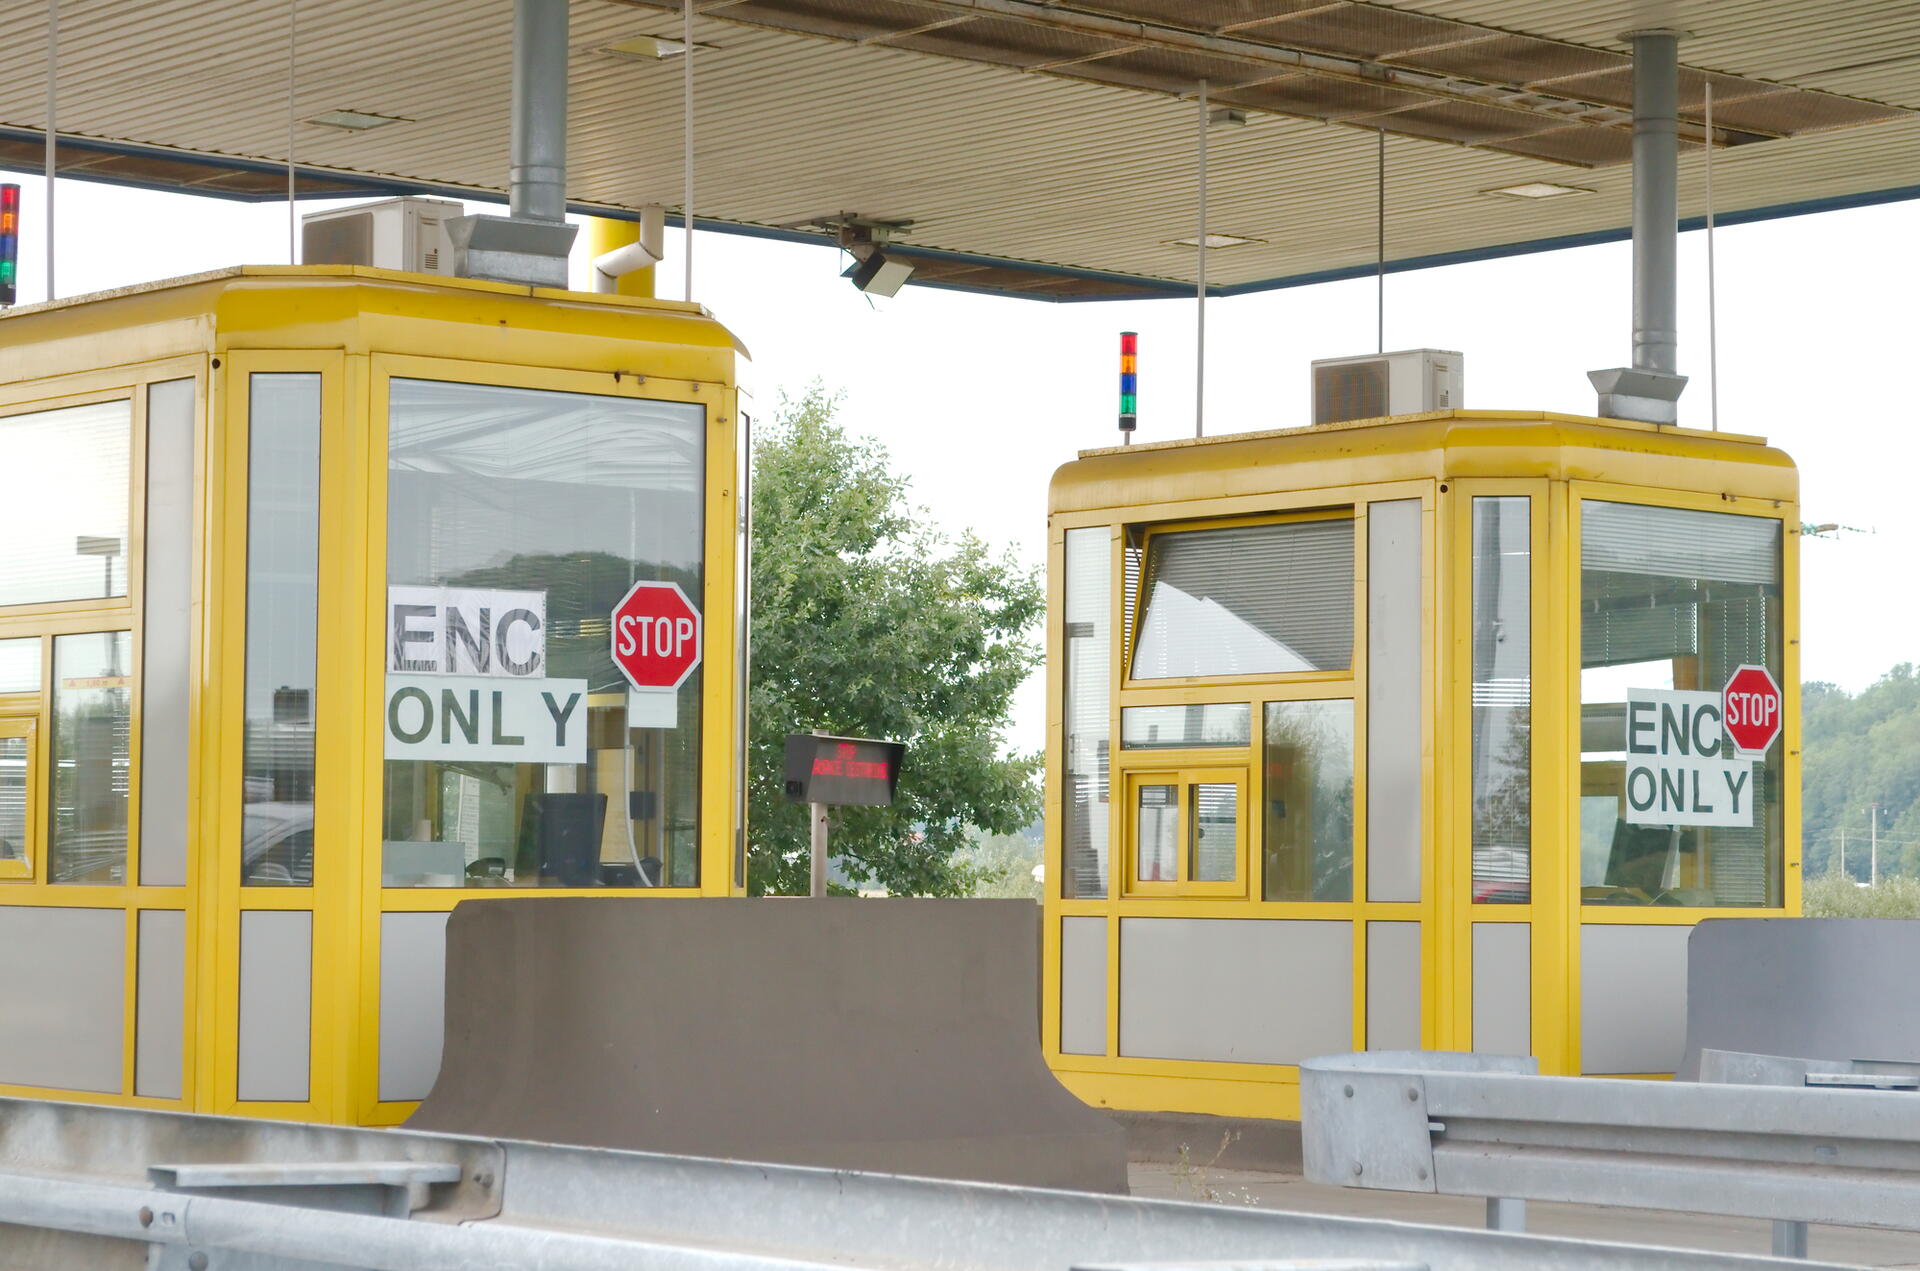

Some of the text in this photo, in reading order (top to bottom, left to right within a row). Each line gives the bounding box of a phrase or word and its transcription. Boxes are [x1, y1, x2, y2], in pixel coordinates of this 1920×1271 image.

[393, 604, 541, 675] ENC
[619, 616, 694, 658] STOP
[388, 687, 582, 747] ONLY
[1630, 702, 1721, 757] ENC
[1727, 693, 1776, 727] STOP
[1628, 766, 1747, 814] ONLY
